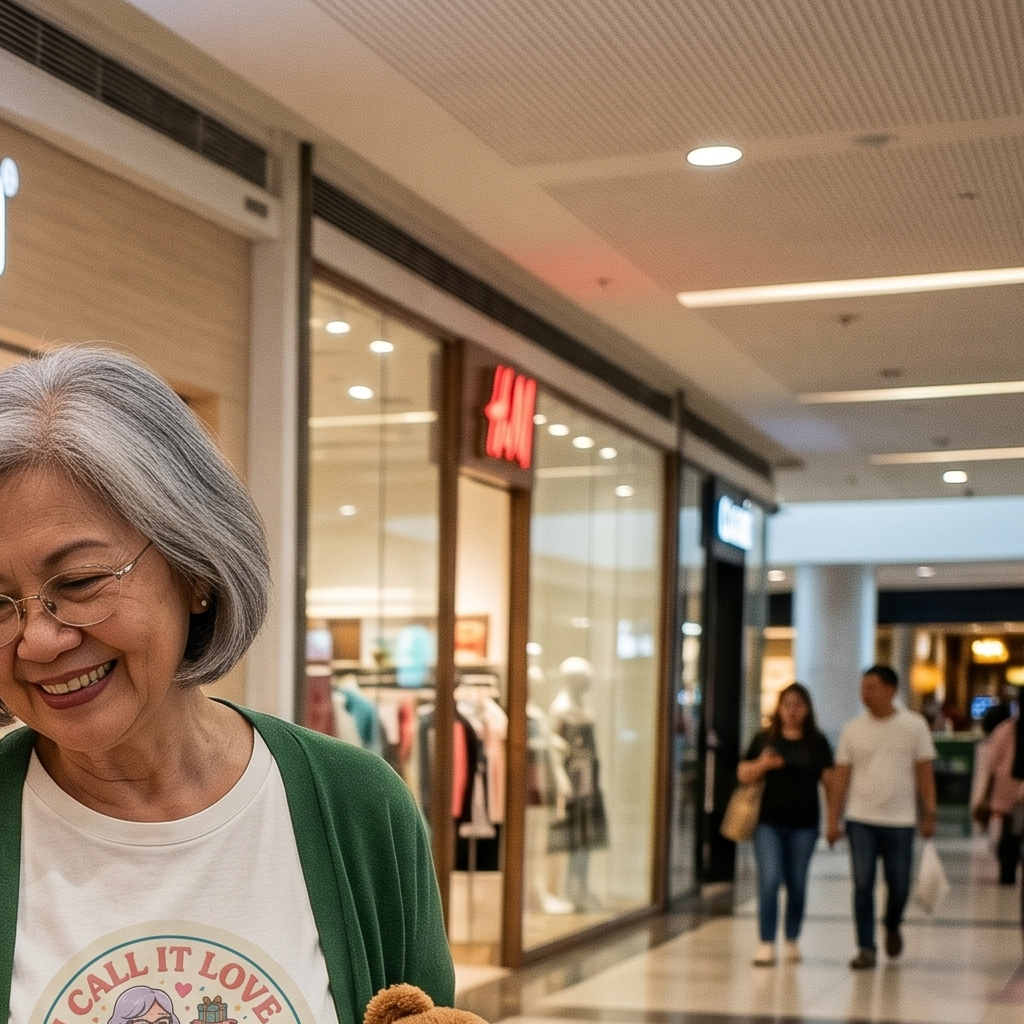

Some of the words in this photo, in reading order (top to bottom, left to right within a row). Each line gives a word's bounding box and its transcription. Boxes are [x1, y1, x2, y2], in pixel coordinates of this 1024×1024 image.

[67, 951, 149, 1017] CALL
[156, 946, 192, 973] IT
[198, 951, 283, 1024] LOVE
